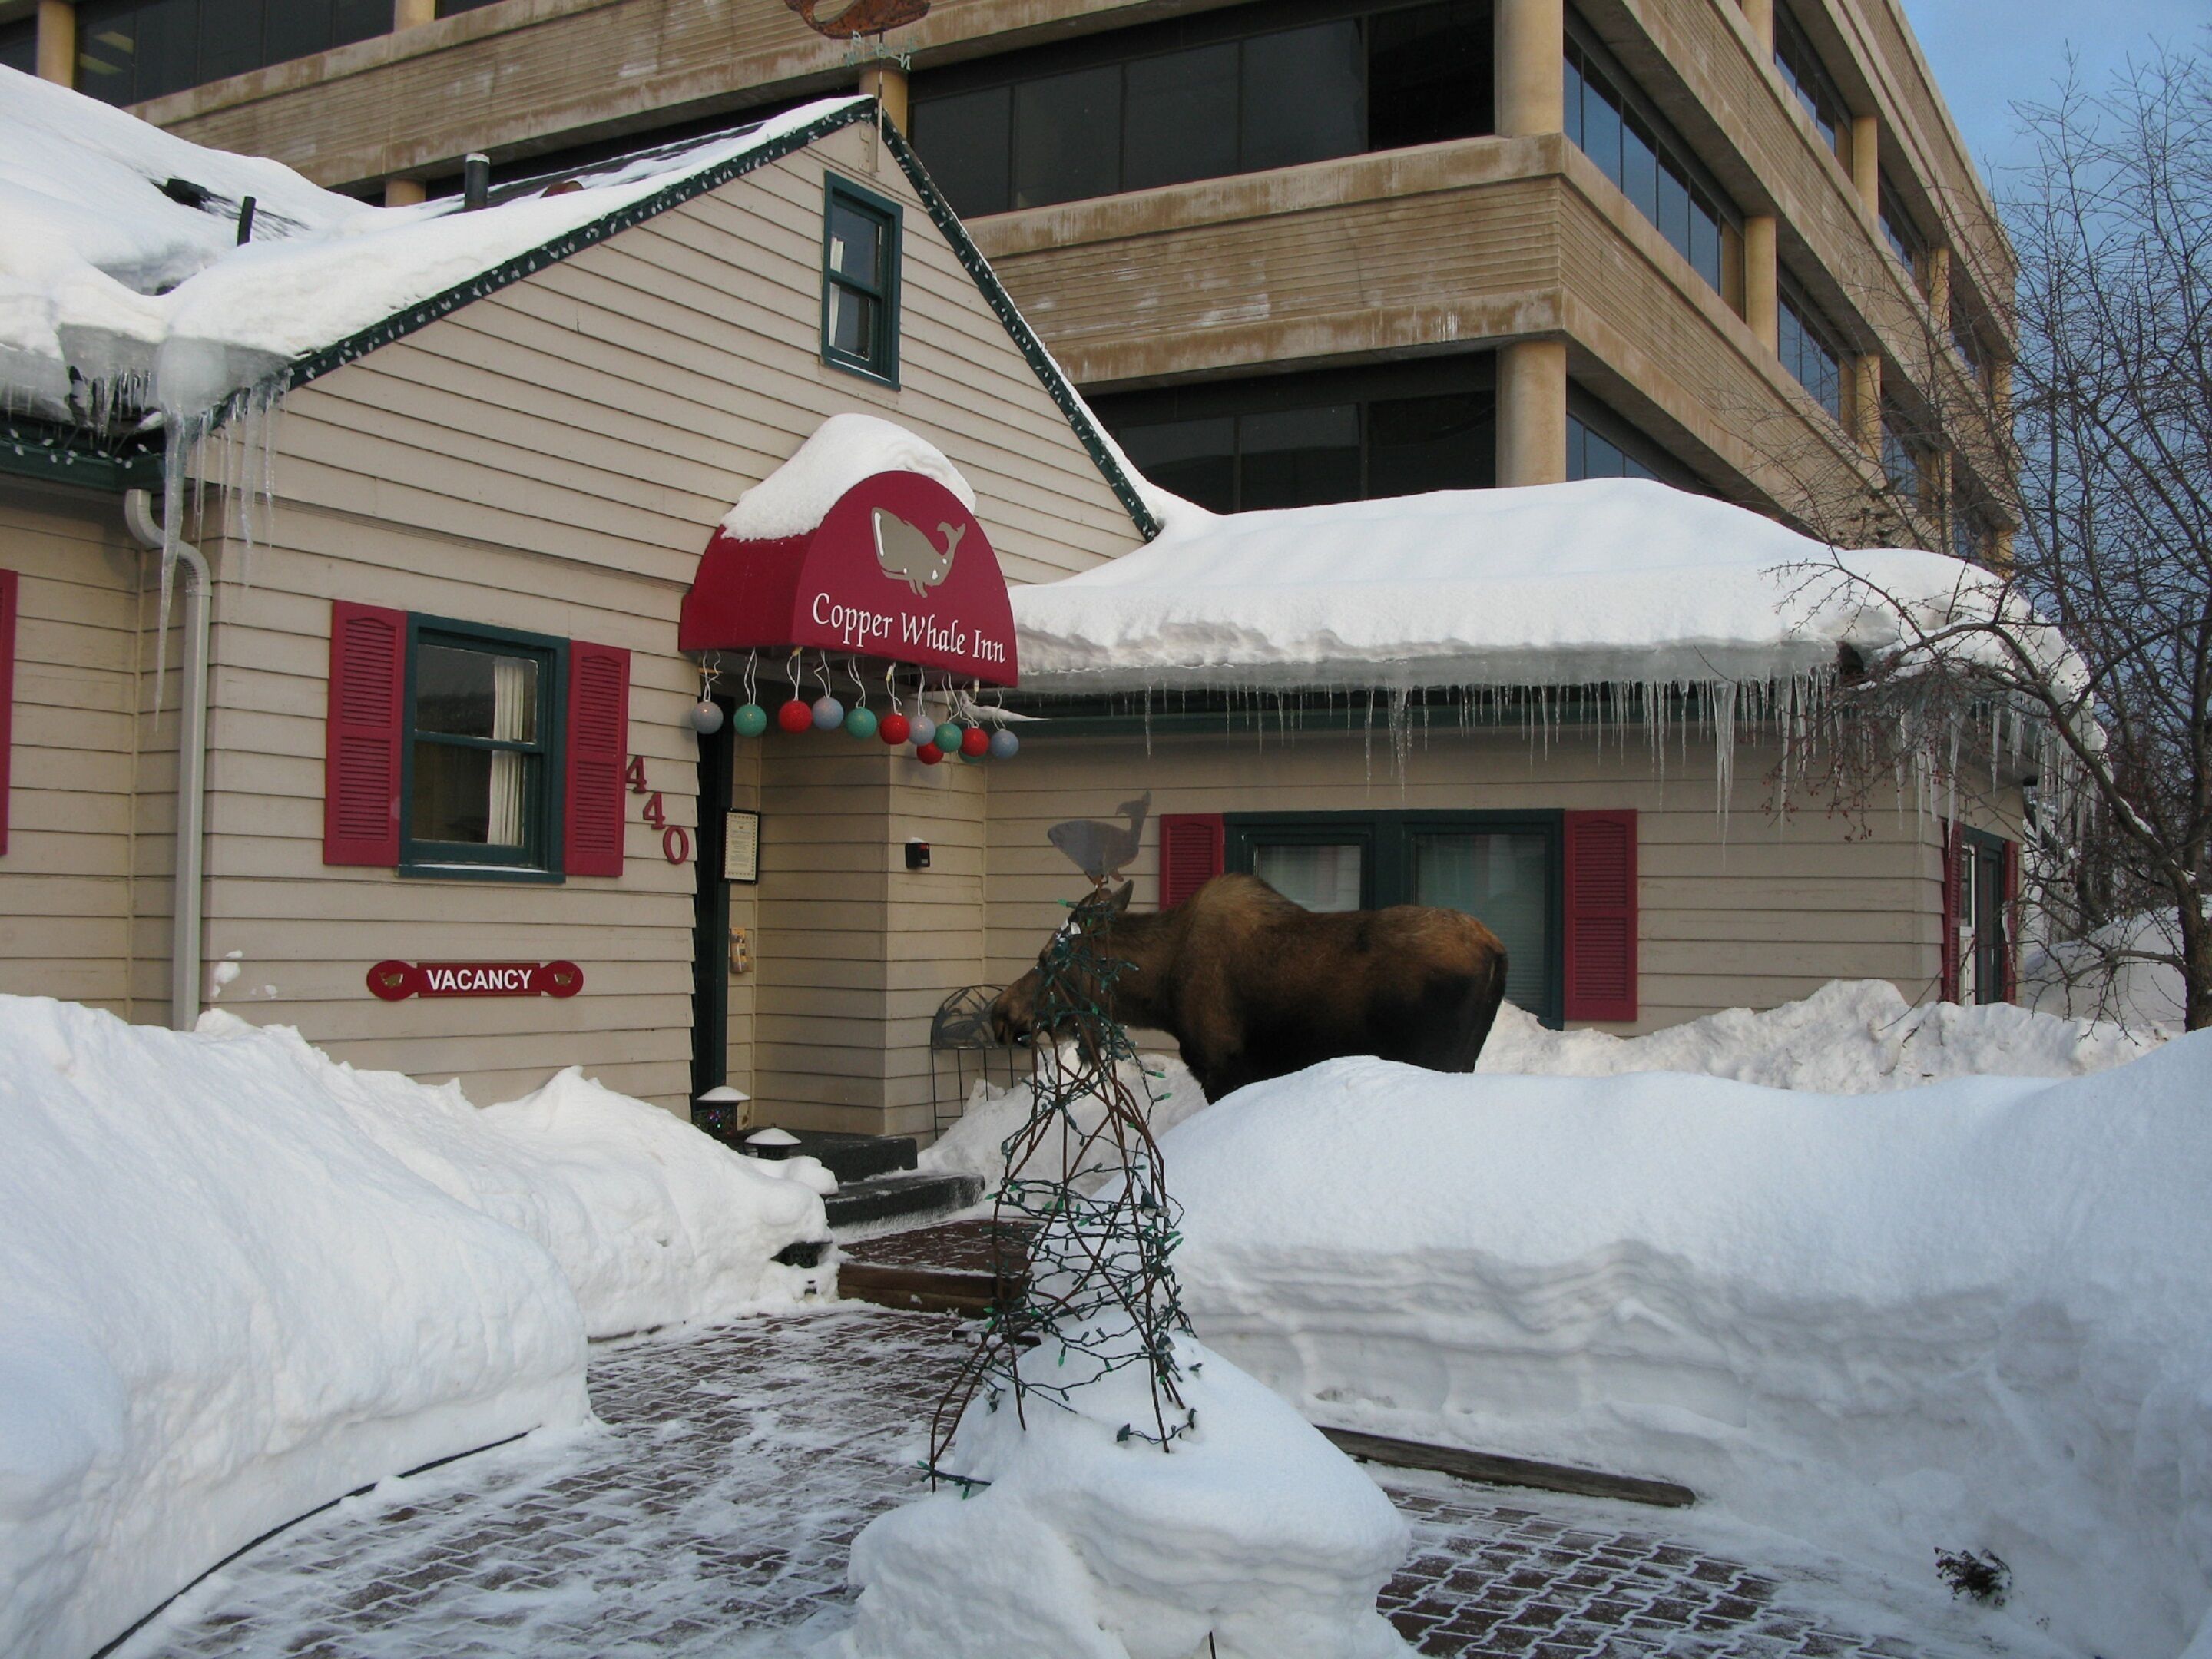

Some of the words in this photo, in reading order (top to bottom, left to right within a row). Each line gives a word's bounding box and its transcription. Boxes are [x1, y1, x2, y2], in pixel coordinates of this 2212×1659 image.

[813, 592, 893, 647] Copper
[901, 612, 965, 655] Whale
[972, 629, 1006, 664] Inn
[625, 755, 689, 865] 440
[426, 969, 532, 990] VACANCY
